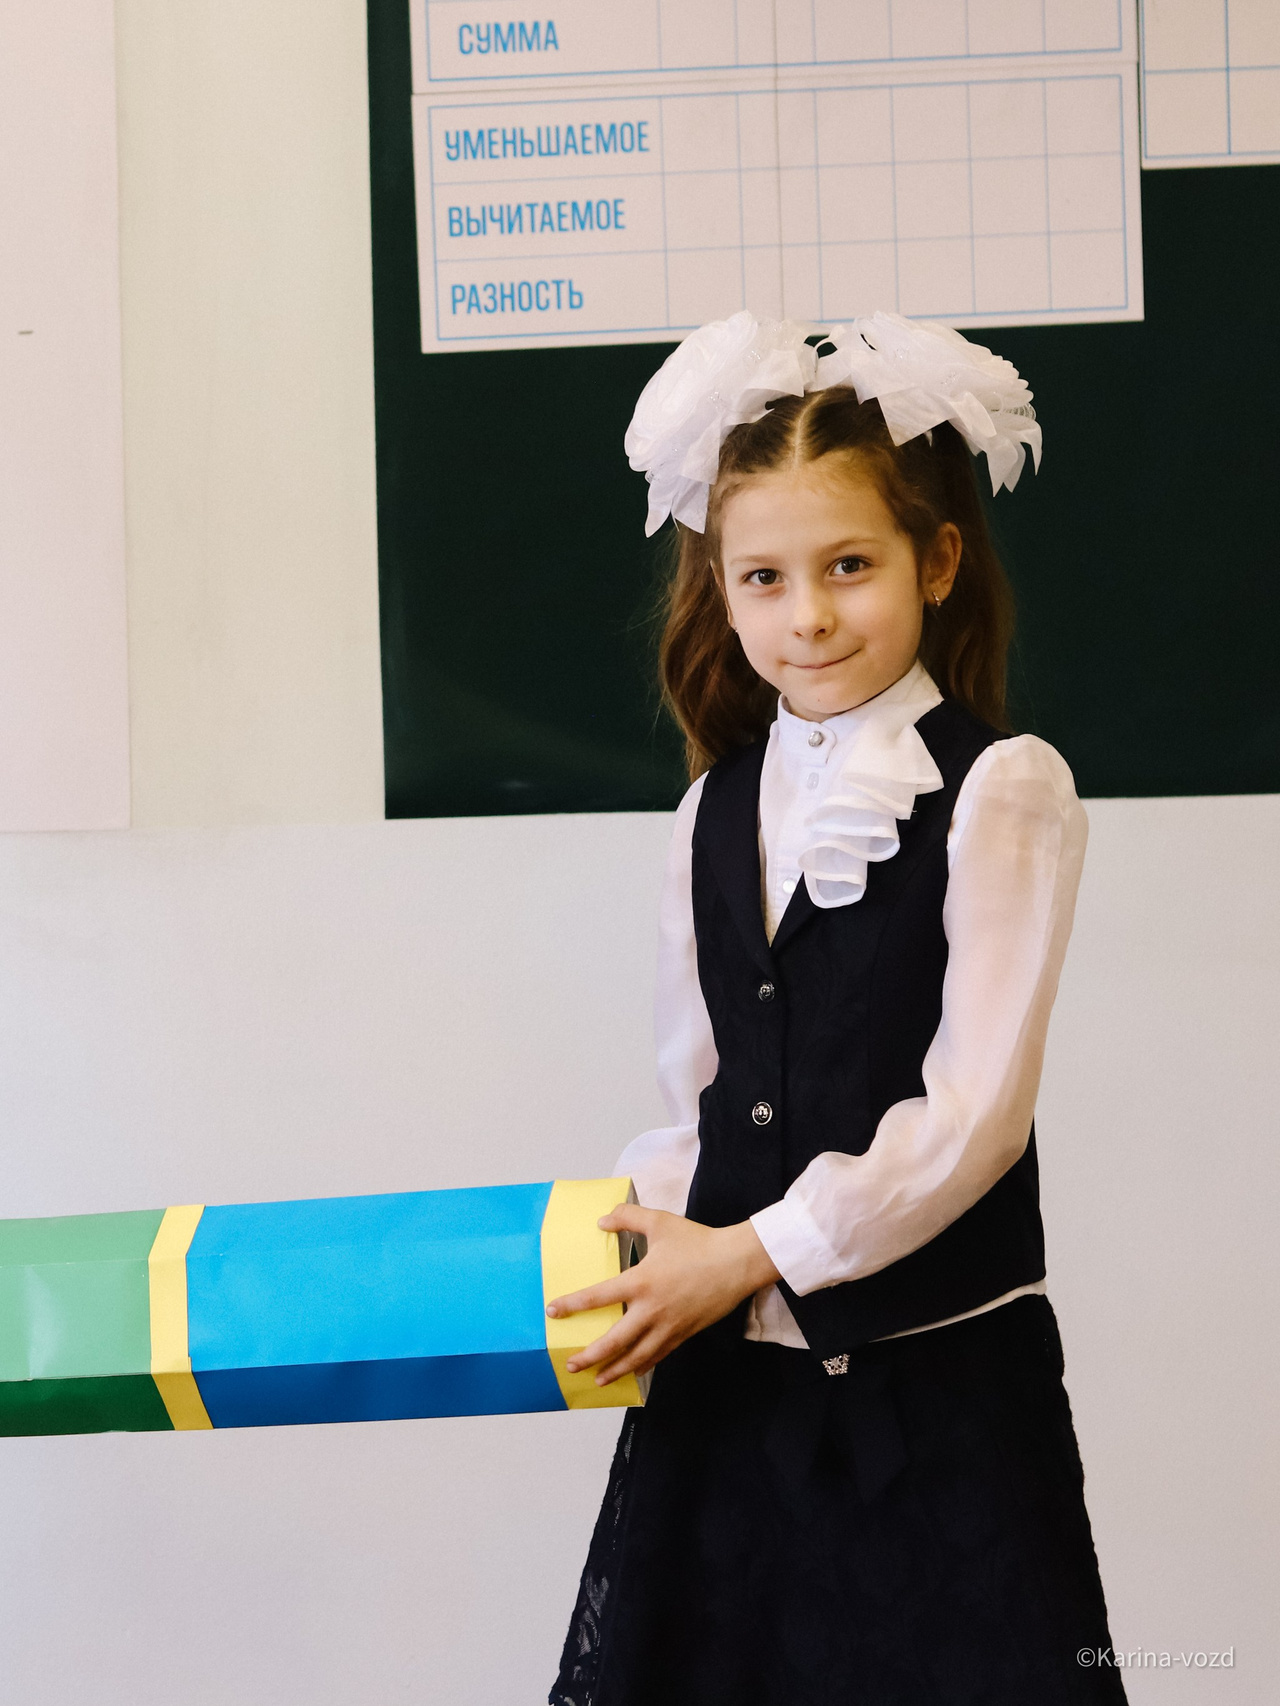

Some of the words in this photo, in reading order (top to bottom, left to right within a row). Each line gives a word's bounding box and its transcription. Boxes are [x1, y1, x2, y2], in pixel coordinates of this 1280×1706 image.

[459, 21, 558, 54] СУММА
[446, 122, 647, 161] УМЕНЬШАЕМОЕ
[449, 200, 624, 237] ВЫЧИТАЕМОЕ
[452, 280, 583, 314] РАЗНОСТЬ
